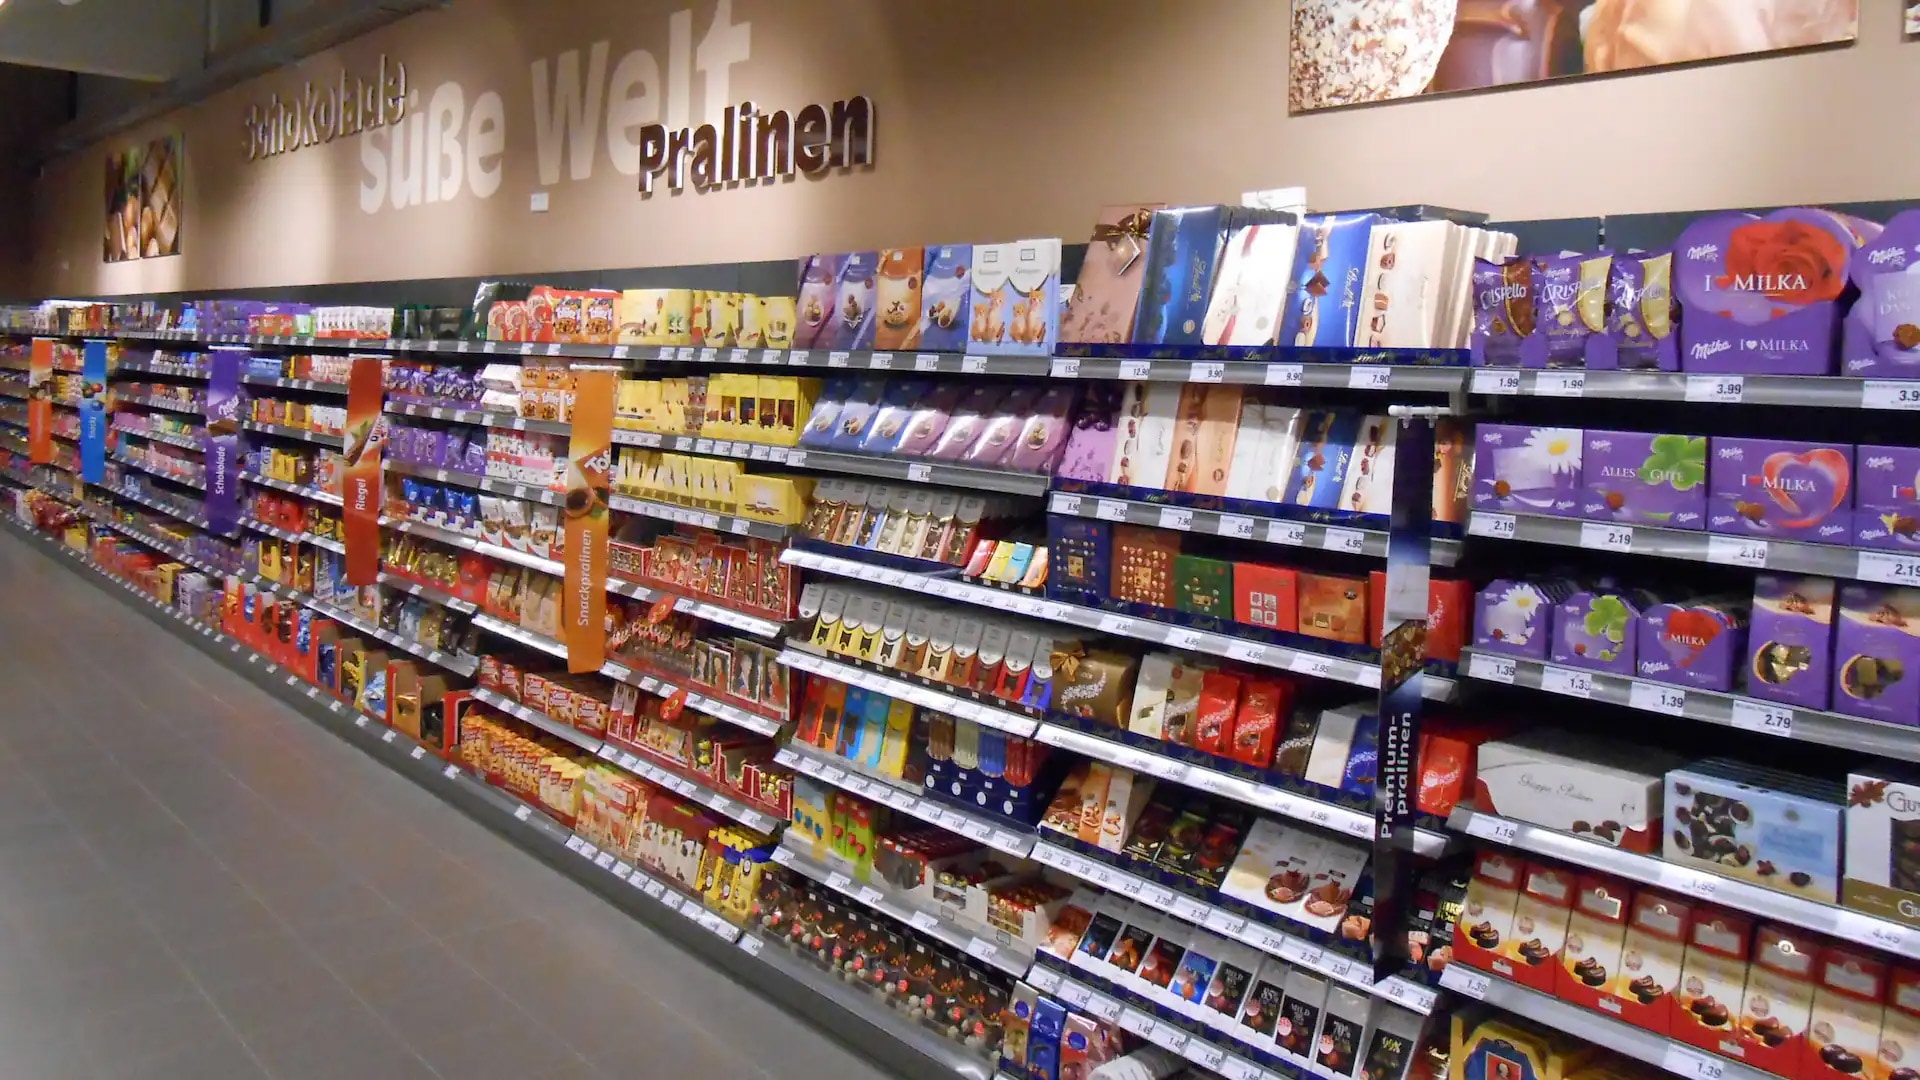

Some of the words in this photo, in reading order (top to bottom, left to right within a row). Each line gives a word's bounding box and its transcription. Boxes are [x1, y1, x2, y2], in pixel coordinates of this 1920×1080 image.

[243, 53, 408, 162] Schokolade
[638, 96, 875, 193] Pralinen
[1704, 275, 1712, 292] I
[1734, 274, 1807, 291] MILKA
[1690, 339, 1732, 360] Milka
[1760, 339, 1809, 351] MILKA
[1207, 370, 1223, 379] 9.90
[1372, 374, 1390, 384] 7.90
[1499, 377, 1519, 388] 1.99
[1562, 379, 1583, 390] 1.99
[1716, 383, 1742, 395] 3.99
[215, 445, 226, 496] Schokolade
[1600, 465, 1636, 478] ALLES
[1763, 476, 1816, 492] MILKA
[355, 478, 366, 511] Riegel
[1177, 517, 1192, 526] 7.90
[1494, 521, 1514, 532] 2.19
[1288, 531, 1304, 541] 4.95
[1608, 532, 1631, 545] 2.19
[1345, 539, 1362, 549] 4.95
[1740, 546, 1765, 560] 2.19
[577, 529, 592, 626] Snackpralinen
[1671, 634, 1707, 646] MILKA
[1495, 664, 1515, 676] 1.39
[1661, 694, 1684, 708] 1.39
[1764, 714, 1791, 729] 2.79
[1397, 712, 1411, 814] pralinen
[1381, 715, 1398, 838] Premium-
[1494, 826, 1515, 839] 1.19
[1124, 884, 1138, 894] 2.70
[1155, 895, 1170, 905] 2.70
[1225, 922, 1241, 933] 2.70
[1262, 937, 1279, 948] 2.70
[1300, 952, 1317, 964] 2.70
[1466, 978, 1488, 992] 1.39
[1697, 1061, 1722, 1079] 1.39
